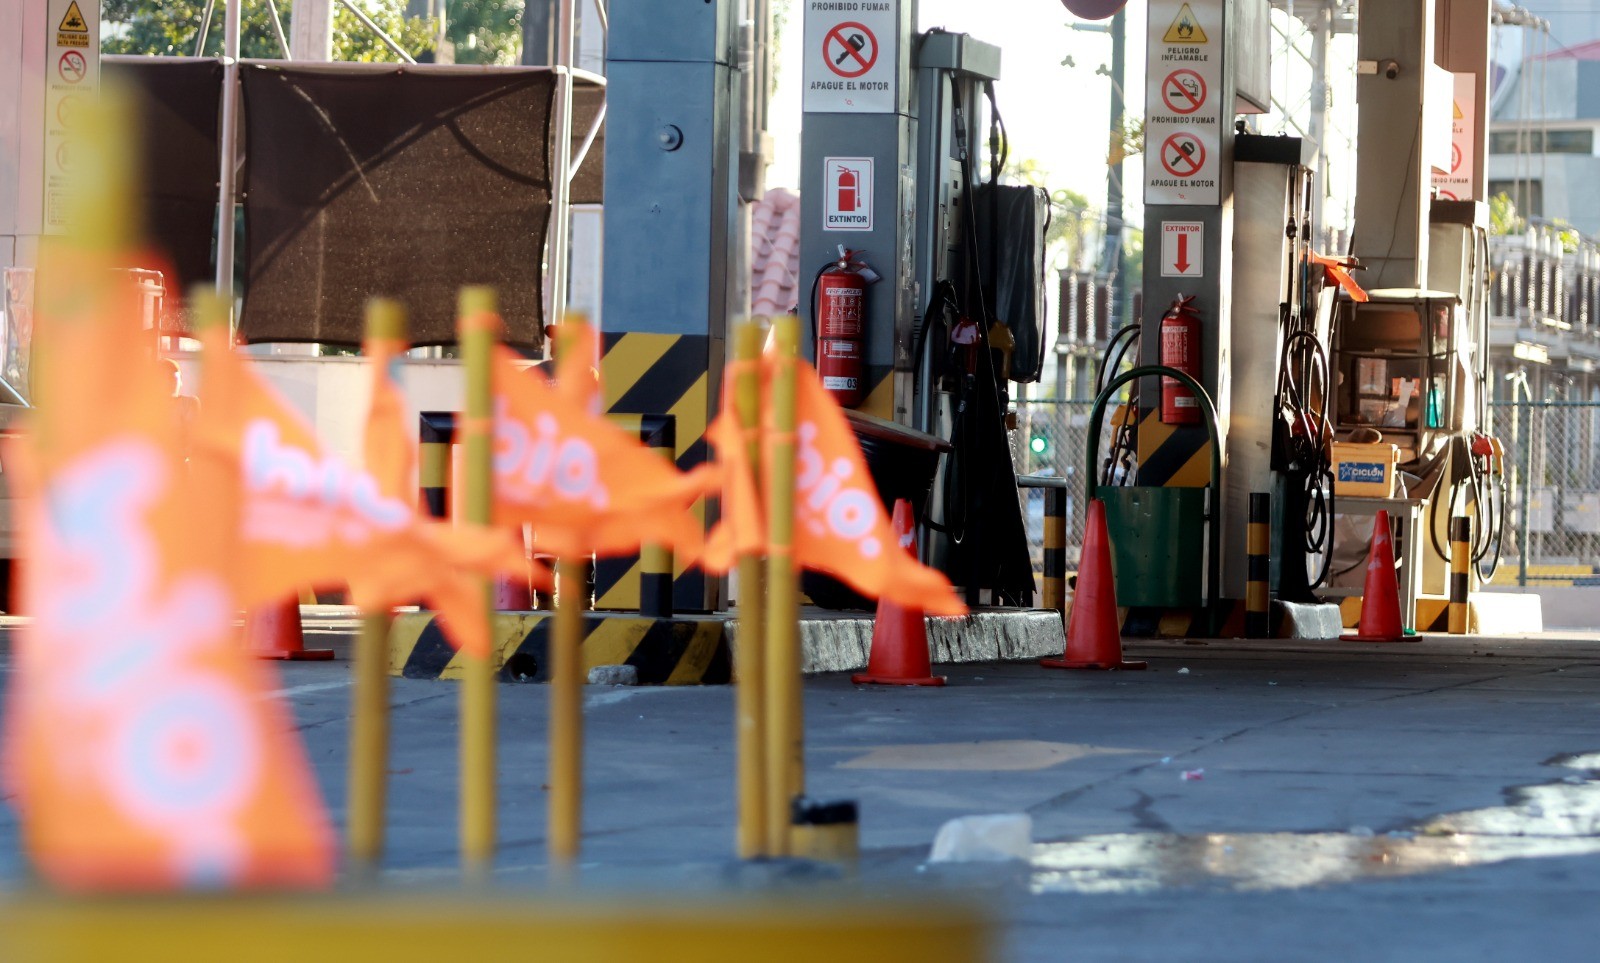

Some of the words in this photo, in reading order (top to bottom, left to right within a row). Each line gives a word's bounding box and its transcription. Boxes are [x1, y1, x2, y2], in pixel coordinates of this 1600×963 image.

[811, 2, 858, 11] PROHIBIDO
[861, 3, 890, 11] FUMAR
[1161, 54, 1209, 62] INFLAMABLE
[810, 81, 844, 90] APAGUE
[846, 82, 857, 90] EL
[859, 82, 889, 90] MOTOR
[1151, 116, 1190, 124] PROHIBIDO
[1191, 116, 1216, 124] FUMAR
[1151, 179, 1178, 187] APAGUE
[828, 215, 868, 223] EXTINTOR
[847, 378, 857, 388] 03
